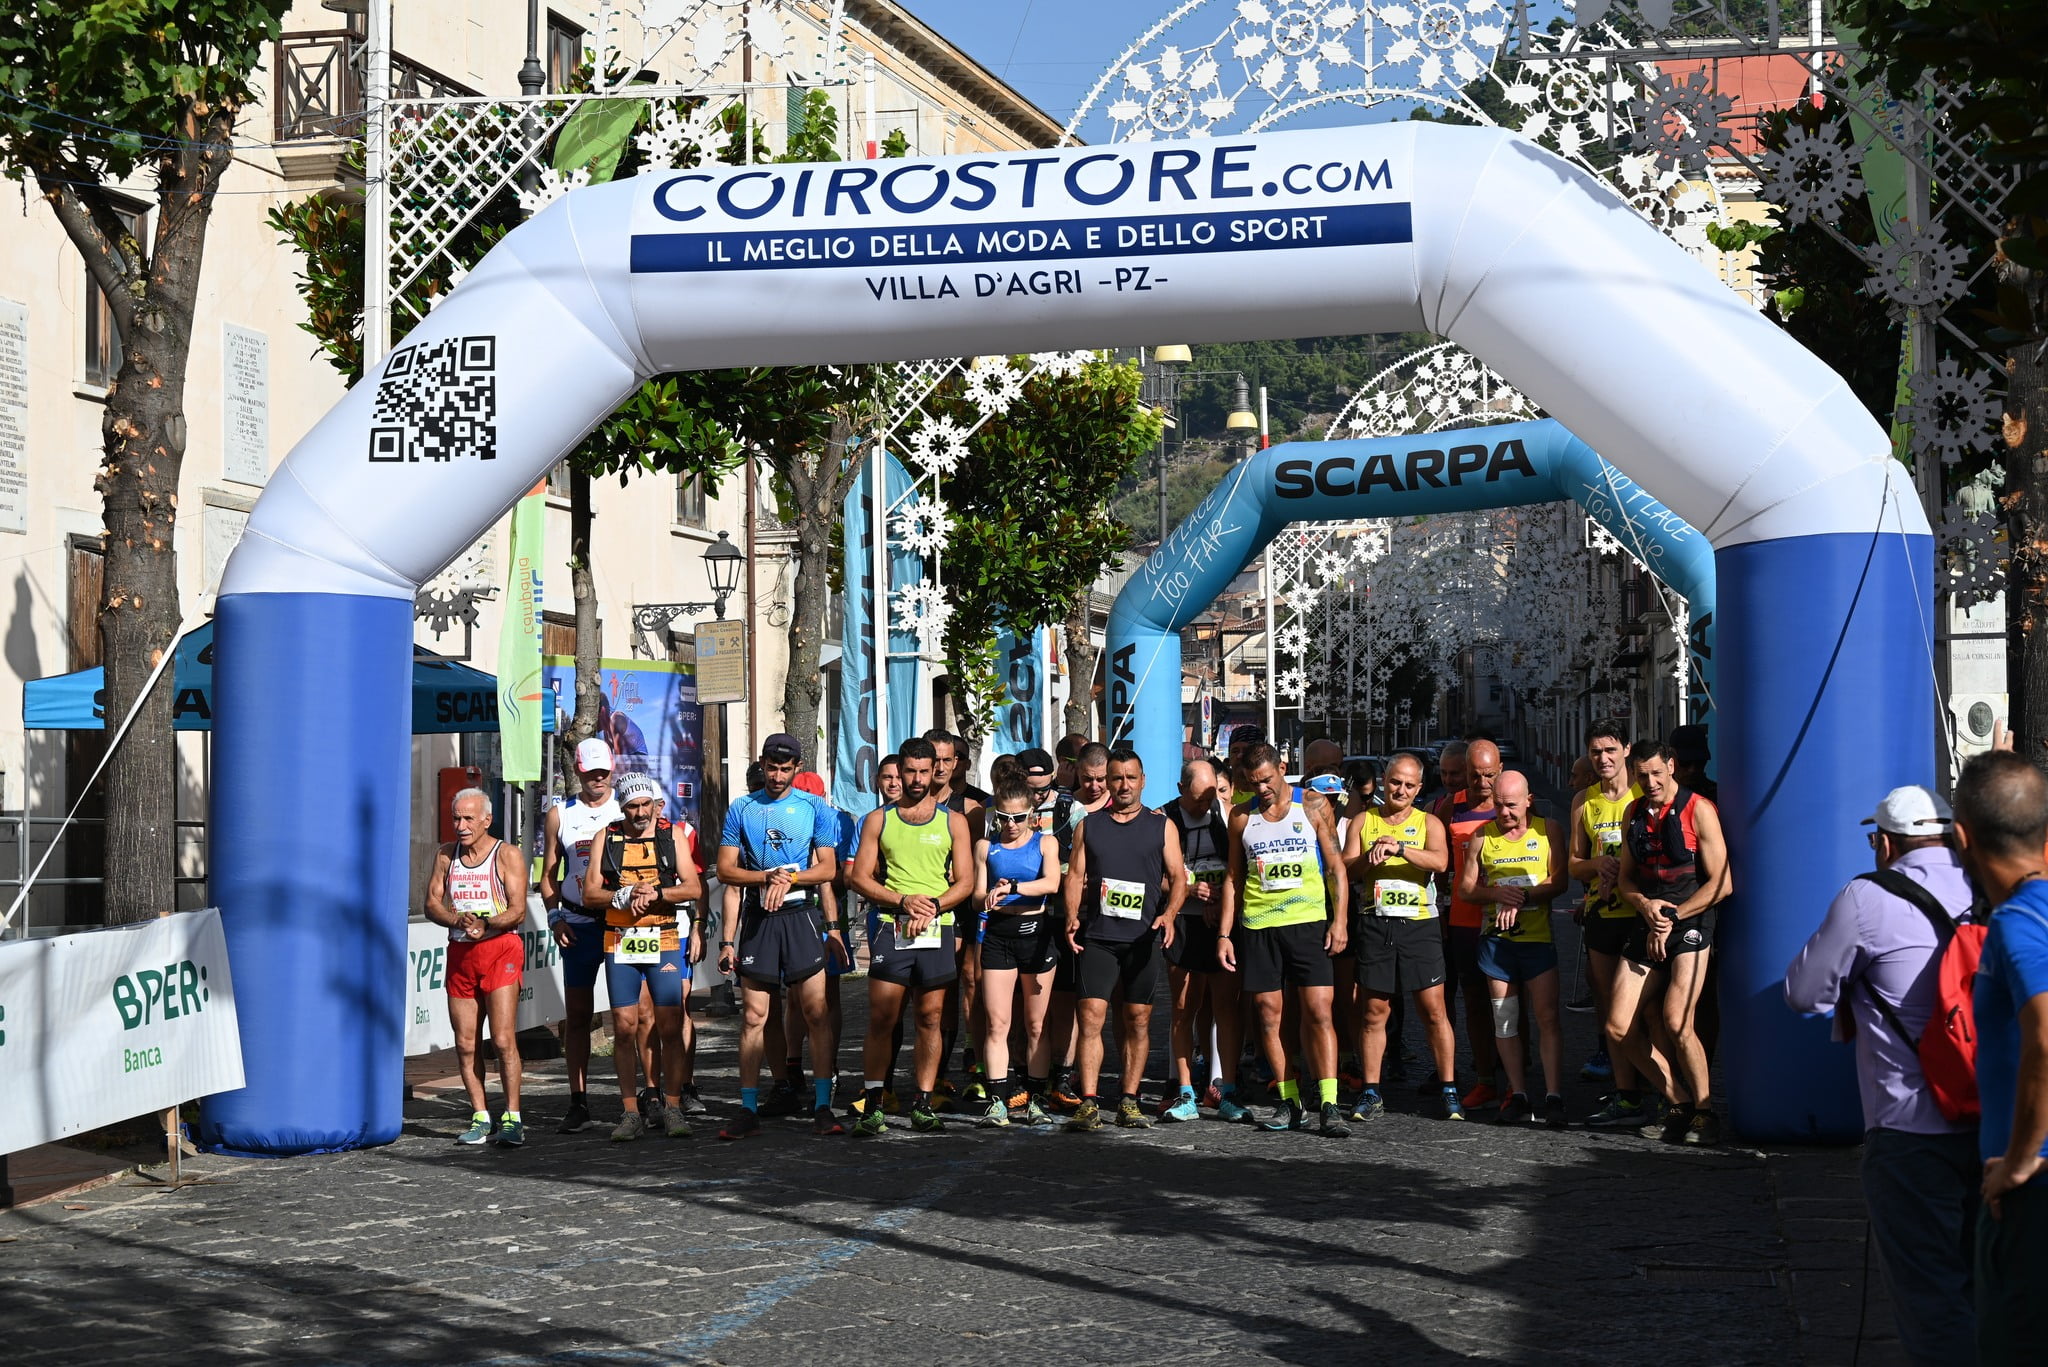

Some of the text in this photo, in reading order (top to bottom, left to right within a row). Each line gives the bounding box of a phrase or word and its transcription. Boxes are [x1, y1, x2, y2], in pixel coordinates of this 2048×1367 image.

[707, 215, 1328, 263] IL MEGLIO DELLA MODA E DELLO SPORT
[865, 266, 1169, 301] VILLA D'AGRI -PZ-
[1274, 438, 1537, 500] SCARPA
[1596, 464, 1697, 543] NO PLACE
[1144, 492, 1216, 585] NO PLACE
[1151, 571, 1189, 608] TOO
[1009, 632, 1035, 744] SCA
[1690, 611, 1713, 734] RPA
[436, 691, 499, 724] SCAR
[1112, 643, 1135, 751] RPA
[1268, 838, 1308, 849] ATLETICA
[453, 874, 489, 882] MARATHON
[1268, 863, 1303, 879] 469
[453, 890, 489, 900] AIELLO
[1110, 892, 1143, 909] 502
[1386, 892, 1419, 906] 382
[625, 938, 660, 953] 496
[124, 1046, 163, 1074] Banca
